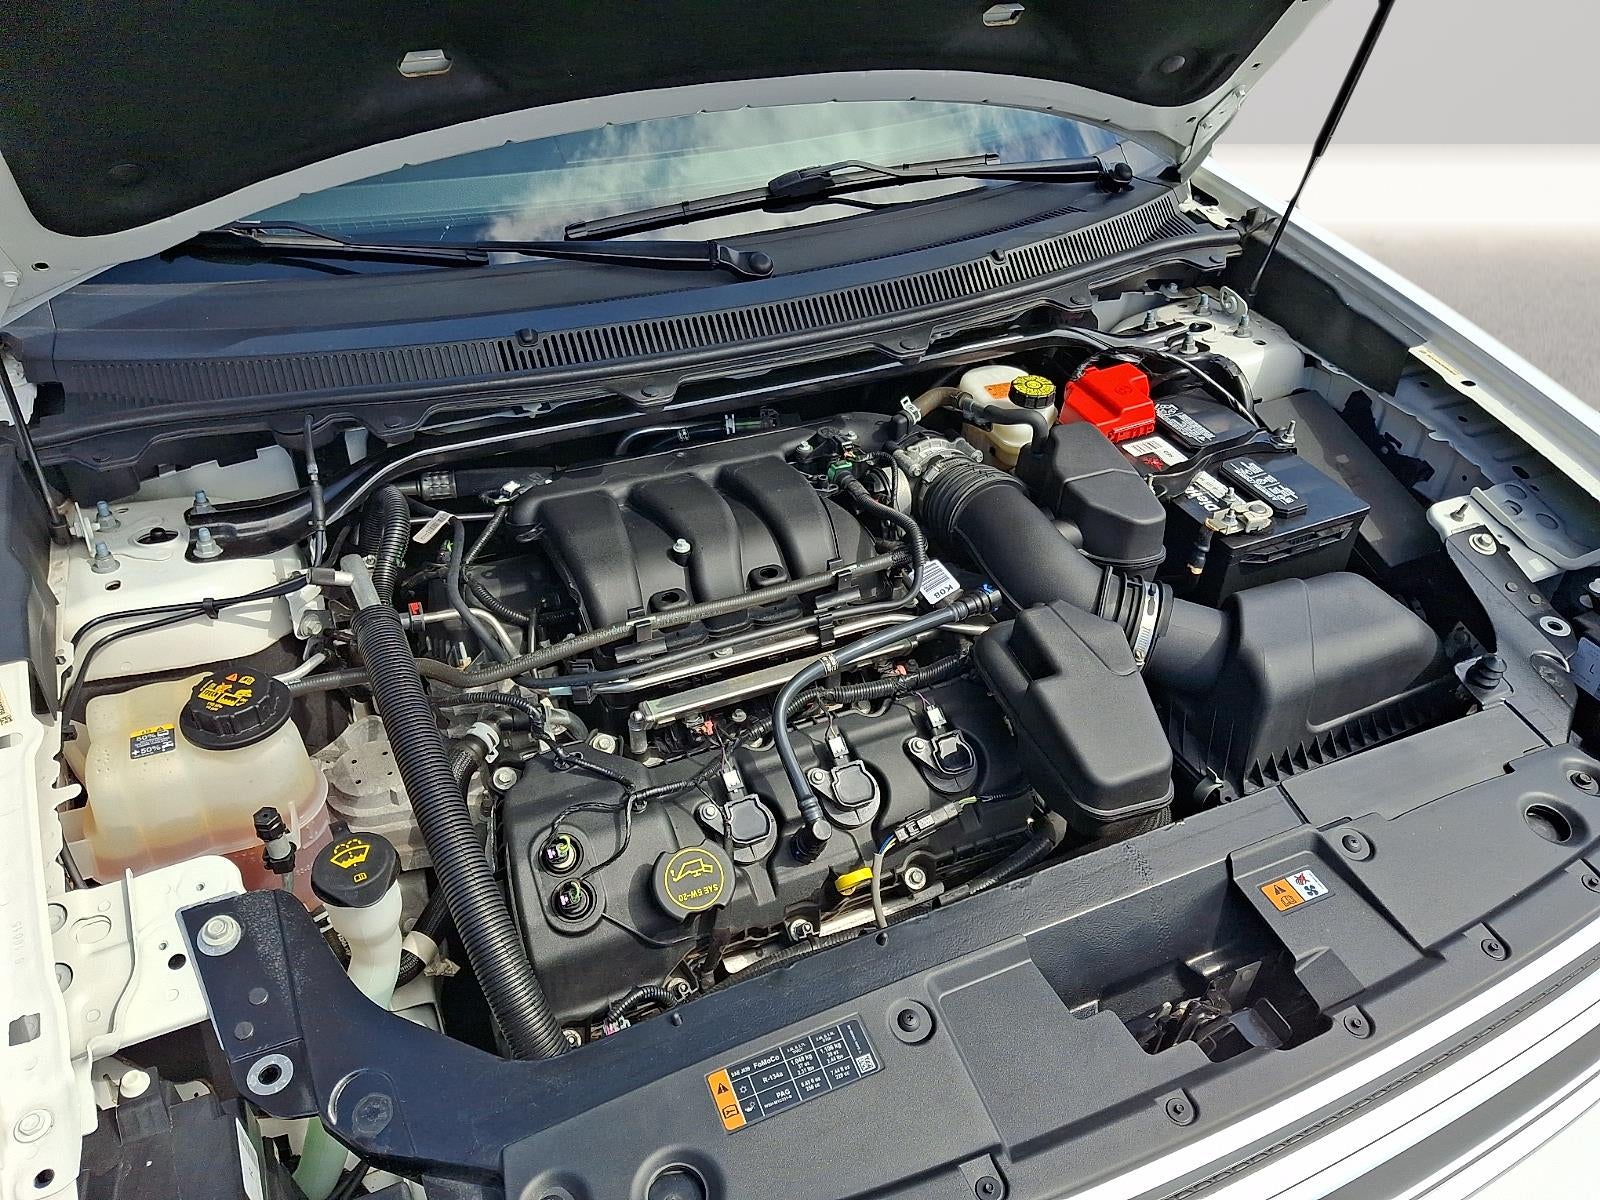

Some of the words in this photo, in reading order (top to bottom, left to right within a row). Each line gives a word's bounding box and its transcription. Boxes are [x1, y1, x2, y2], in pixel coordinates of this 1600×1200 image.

[678, 888, 703, 902] 5W-20
[703, 883, 719, 895] SAE
[753, 1055, 780, 1070] FoMoCo
[776, 1088, 791, 1099] PAG
